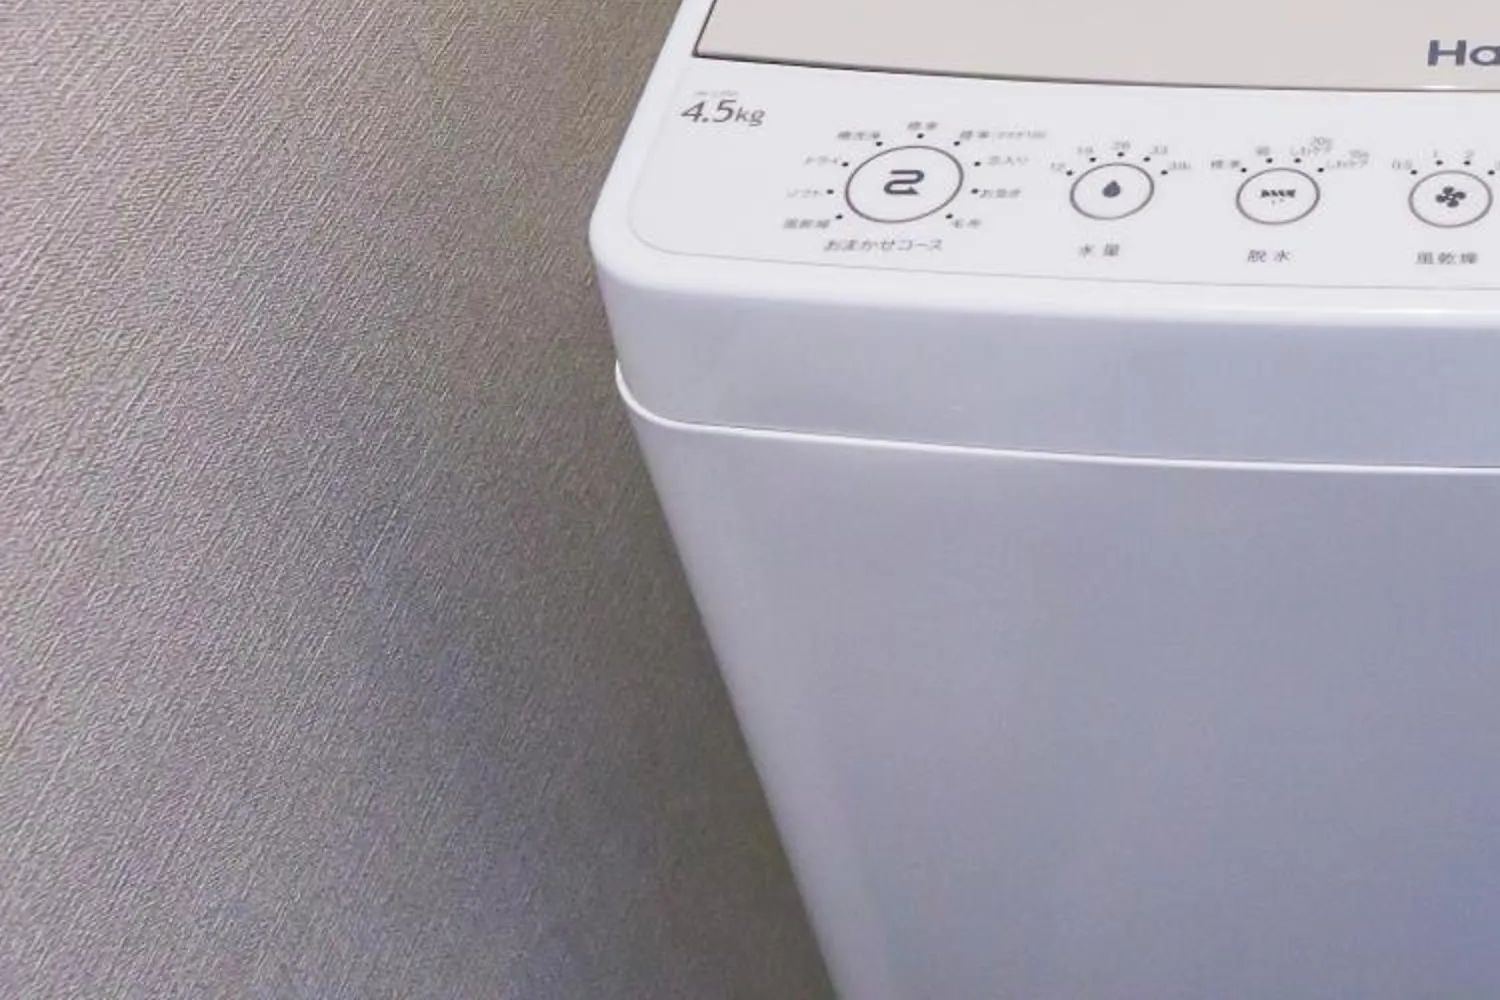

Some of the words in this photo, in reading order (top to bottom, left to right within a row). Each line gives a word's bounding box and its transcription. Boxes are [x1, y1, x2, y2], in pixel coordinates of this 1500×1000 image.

[681, 99, 766, 126] 4.5kg
[824, 238, 943, 252] おまかせコース
[1248, 249, 1291, 262] 脱水
